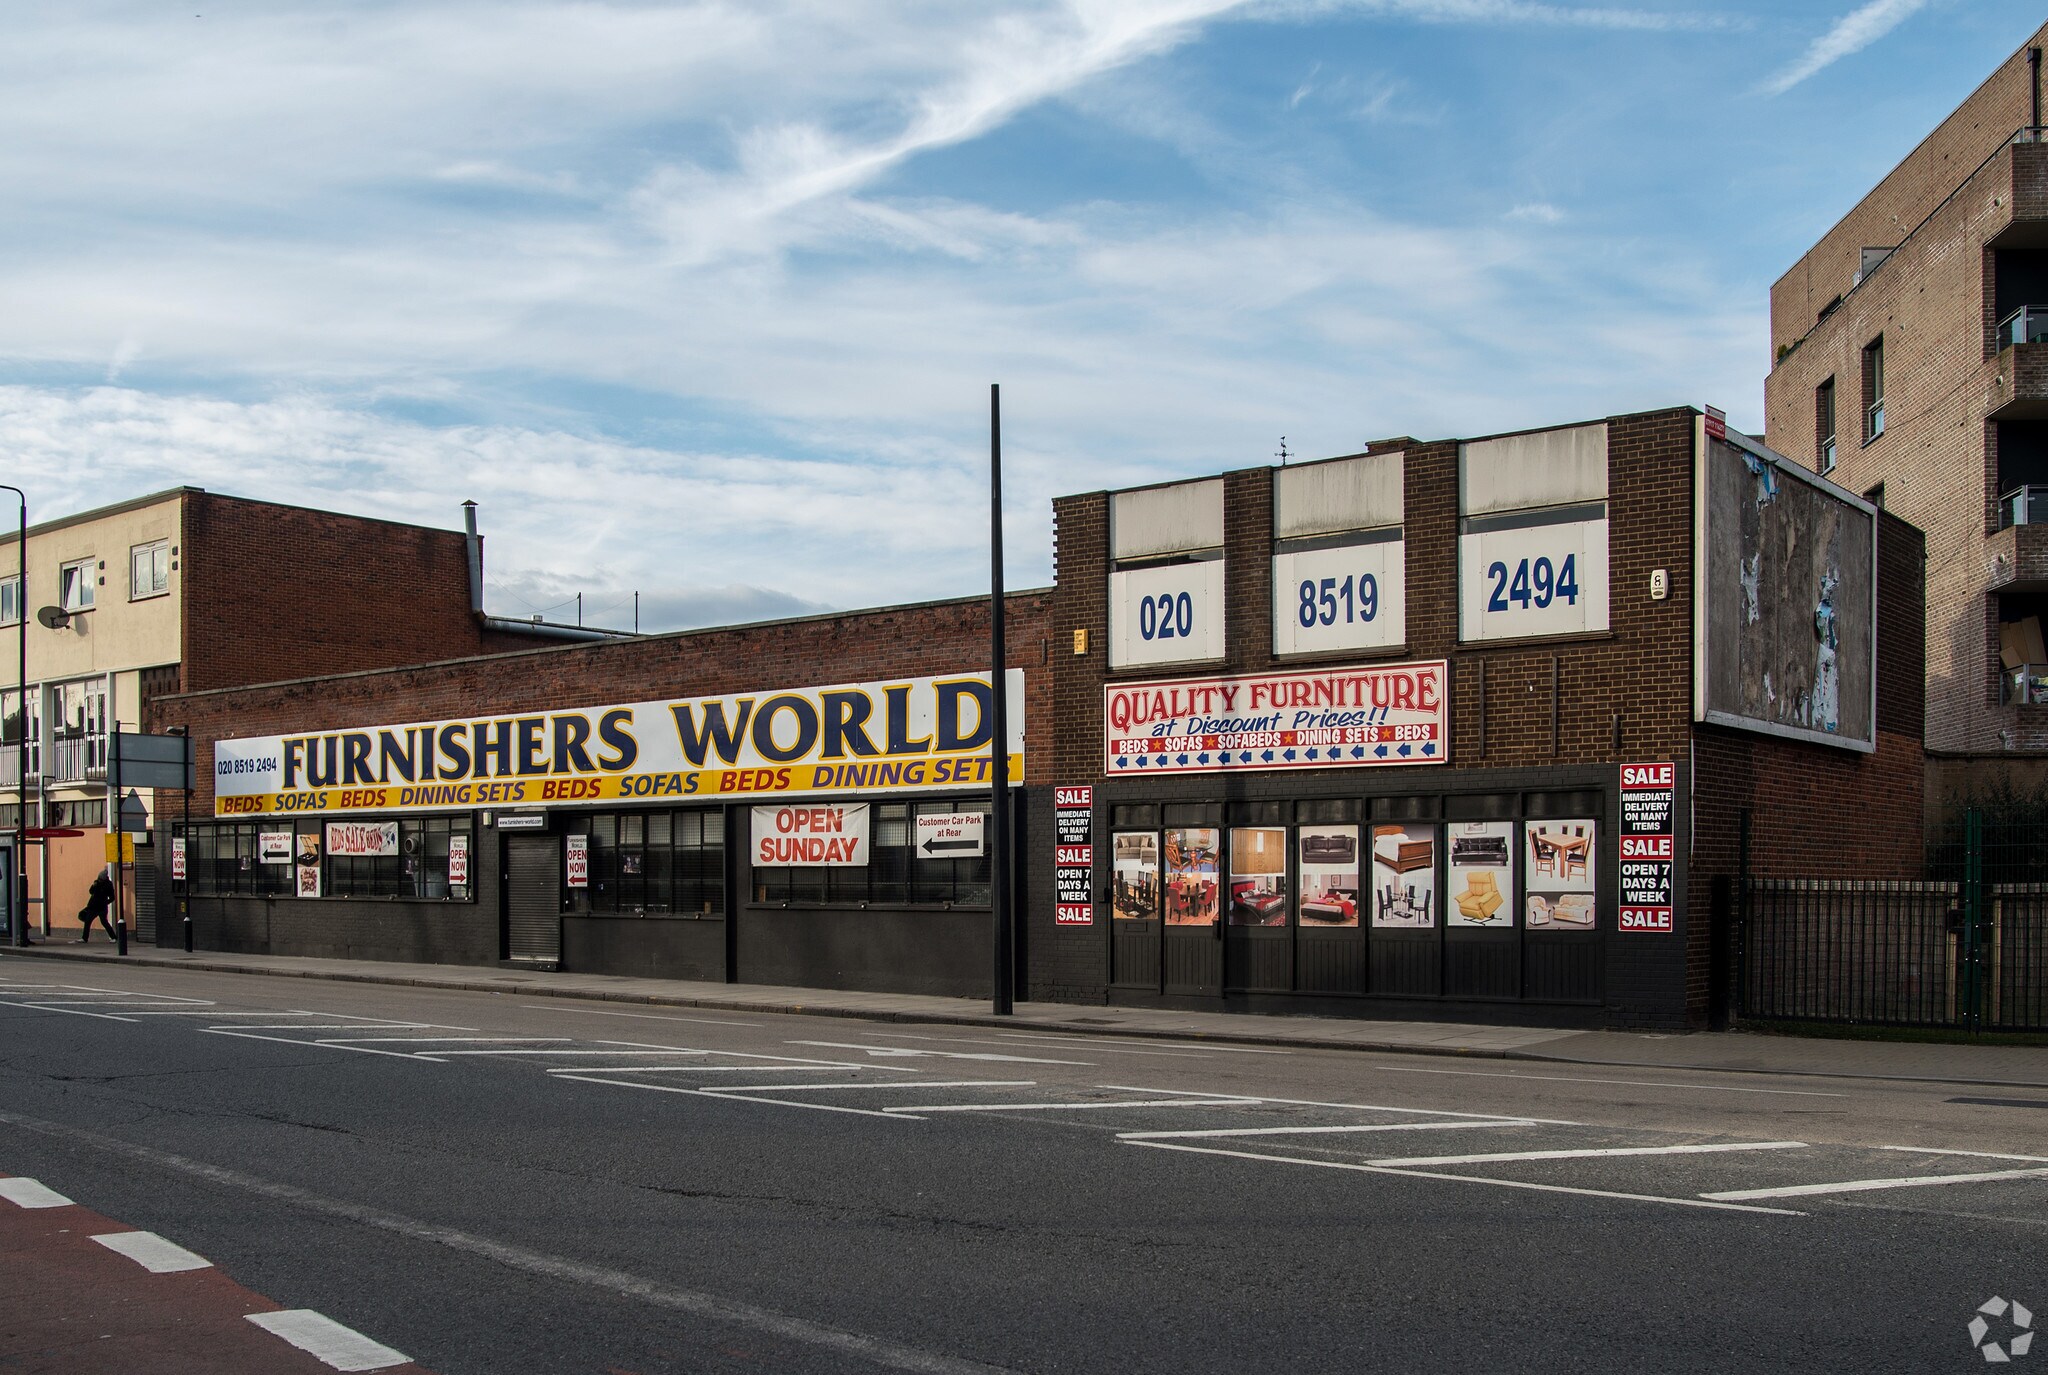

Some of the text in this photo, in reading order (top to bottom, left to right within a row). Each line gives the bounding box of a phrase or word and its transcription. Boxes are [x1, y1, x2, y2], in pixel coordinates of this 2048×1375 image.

[1139, 553, 1580, 641] 020 8519 2494
[1111, 670, 1441, 735] QUALITY FURNITURE
[1151, 706, 1389, 737] at Discount Prices!!
[282, 678, 993, 790] FURNISHERS WORLD
[1119, 724, 1431, 754] BEDS SOFAS SOFABEDS DINING SETS BEDS
[217, 757, 277, 775] 020 8519 2494
[1623, 767, 1672, 785] SALE
[223, 756, 1012, 814] BEDS SOFAS BEDS DINING SETS BEDS SOFAS BEDS DINING SET
[1056, 790, 1090, 804] SALE
[1622, 792, 1672, 802] IMMEDIATE
[1624, 802, 1669, 811] DELIVERY
[1056, 810, 1091, 819] IMMEDIATE
[1625, 812, 1668, 821] ON MANY
[776, 808, 843, 834] OPEN
[918, 815, 982, 827] Customer Car Park
[1058, 818, 1089, 827] DELIVERY
[1632, 822, 1661, 831] ITEMS
[937, 828, 962, 837] at Rear
[1069, 826, 1089, 834] MANY
[331, 826, 383, 853] BEDS SALE BEDS
[1063, 834, 1084, 842] ITEMS
[760, 837, 859, 863] SUNDAY
[1622, 839, 1671, 856] SALE
[173, 850, 186, 859] OPEN
[451, 850, 467, 859] OPEN
[568, 850, 587, 860] OPEN
[1057, 849, 1091, 863] SALE
[174, 861, 185, 869] NOW
[451, 861, 466, 871] NOW
[569, 862, 586, 873] NOW
[1622, 864, 1671, 876] OPEN 7
[1057, 869, 1091, 879] OPEN 7
[1058, 880, 1091, 890] DAYS A
[1622, 878, 1670, 889] DAYS A
[1060, 891, 1088, 901] WEEK
[1626, 891, 1665, 903] WEEK
[1057, 907, 1091, 921] SALE
[1621, 911, 1670, 928] SALE
